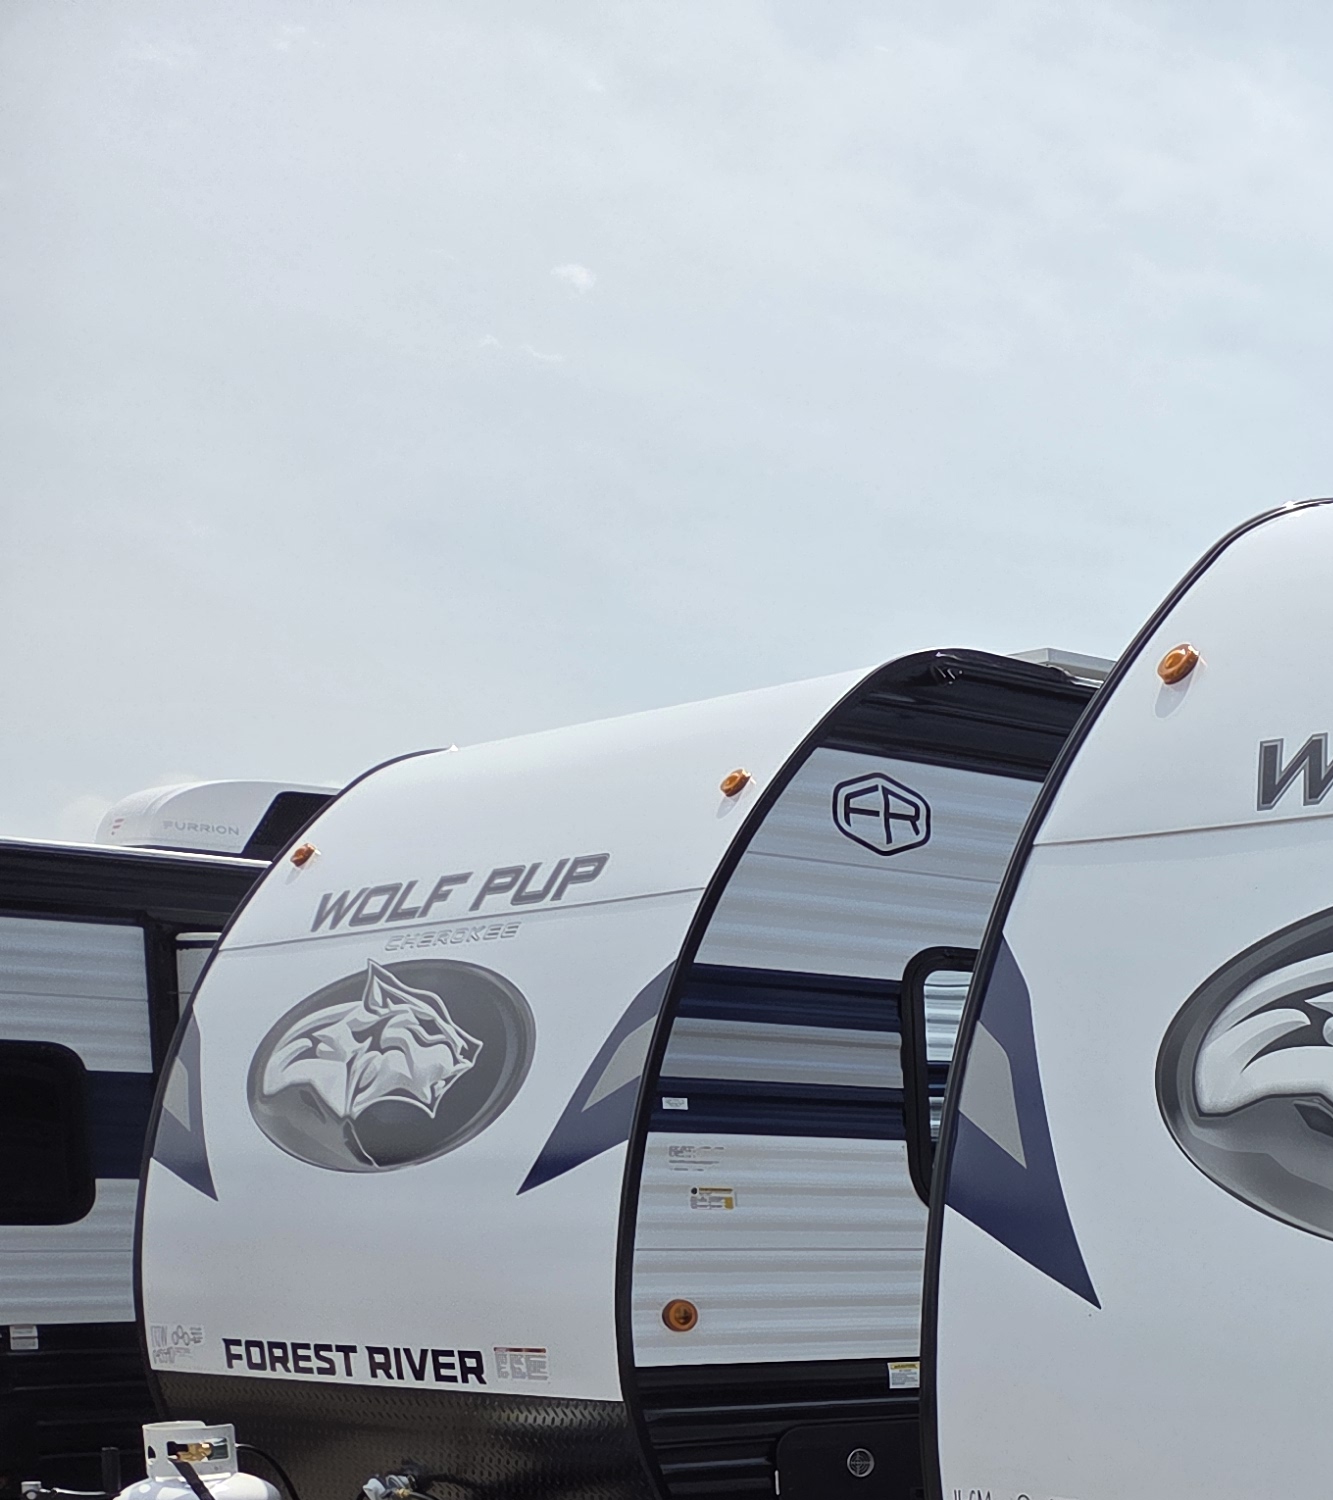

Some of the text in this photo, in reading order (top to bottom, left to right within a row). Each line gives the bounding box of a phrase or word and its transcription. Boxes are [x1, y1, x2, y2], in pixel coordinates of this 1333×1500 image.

[162, 820, 240, 836] FURRION
[310, 852, 611, 932] WOLF PUP
[384, 921, 522, 951] CHEROKEE
[221, 1337, 358, 1377] FOREST
[364, 1345, 487, 1385] RIVER
